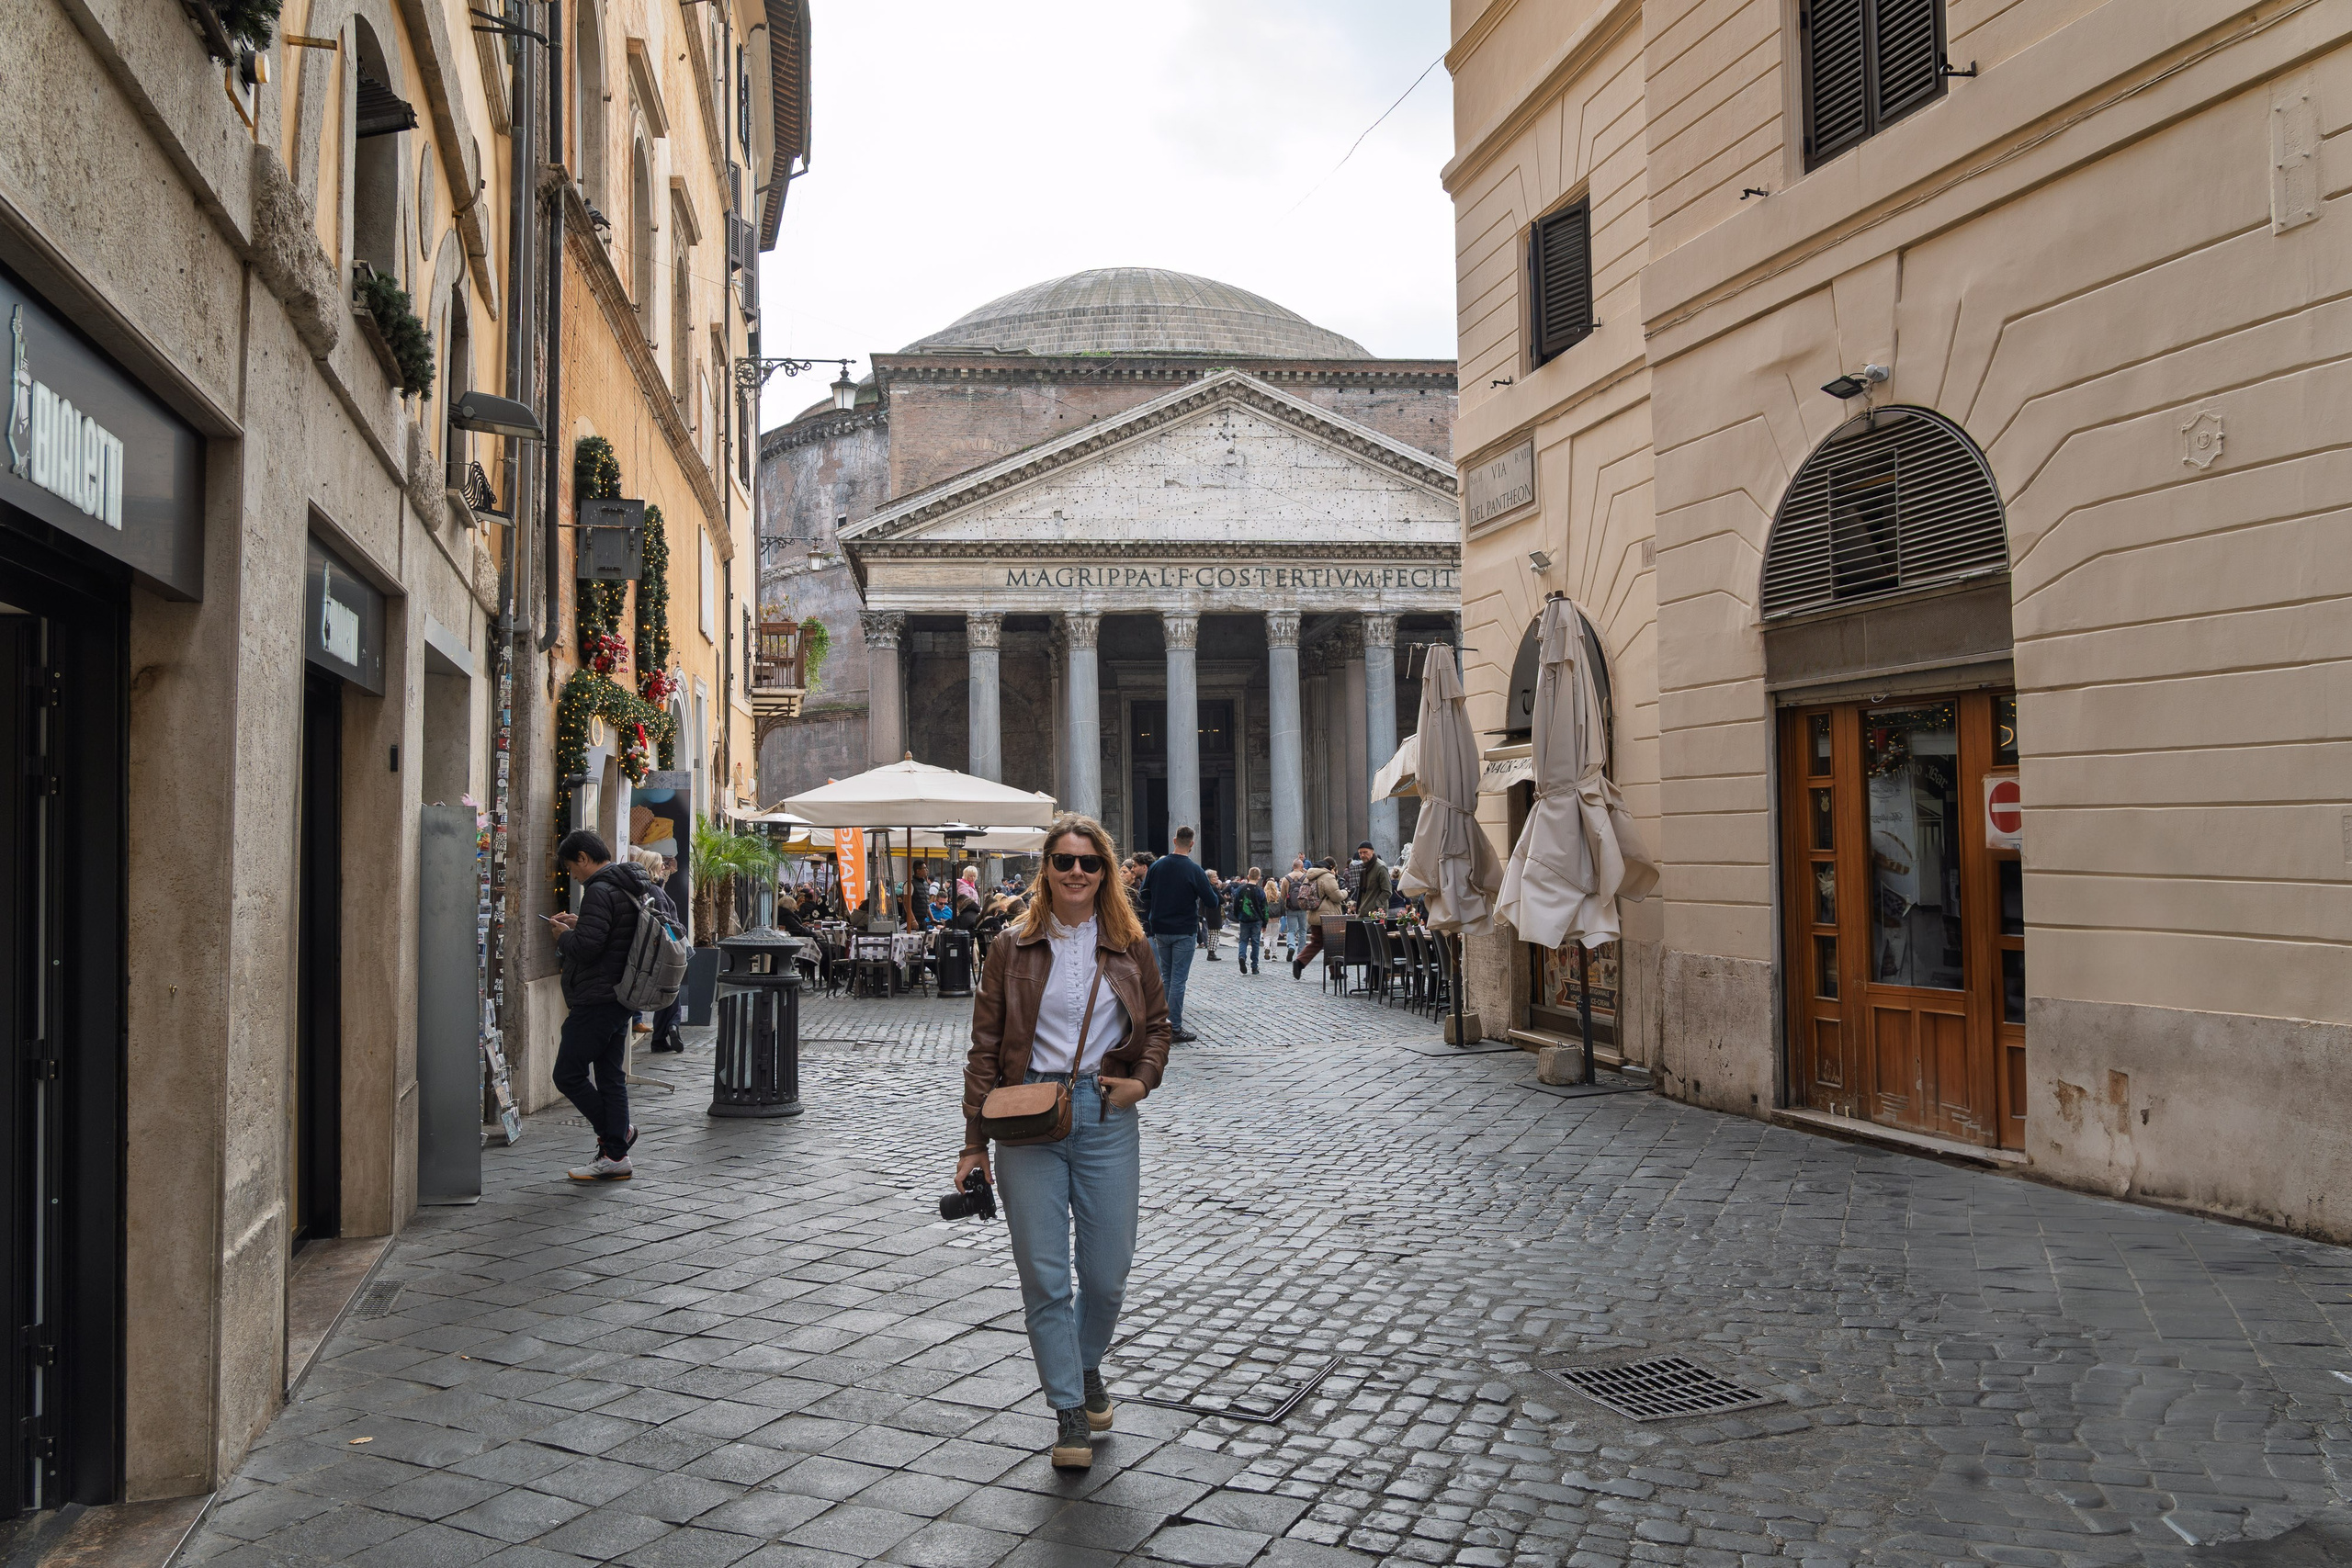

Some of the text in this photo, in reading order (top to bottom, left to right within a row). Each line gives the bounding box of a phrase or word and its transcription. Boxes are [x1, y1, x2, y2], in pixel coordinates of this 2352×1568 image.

[1491, 461, 1507, 479] VIA
[1471, 482, 1532, 523] DEL PANTHEON
[1887, 759, 1948, 788] empio Bar
